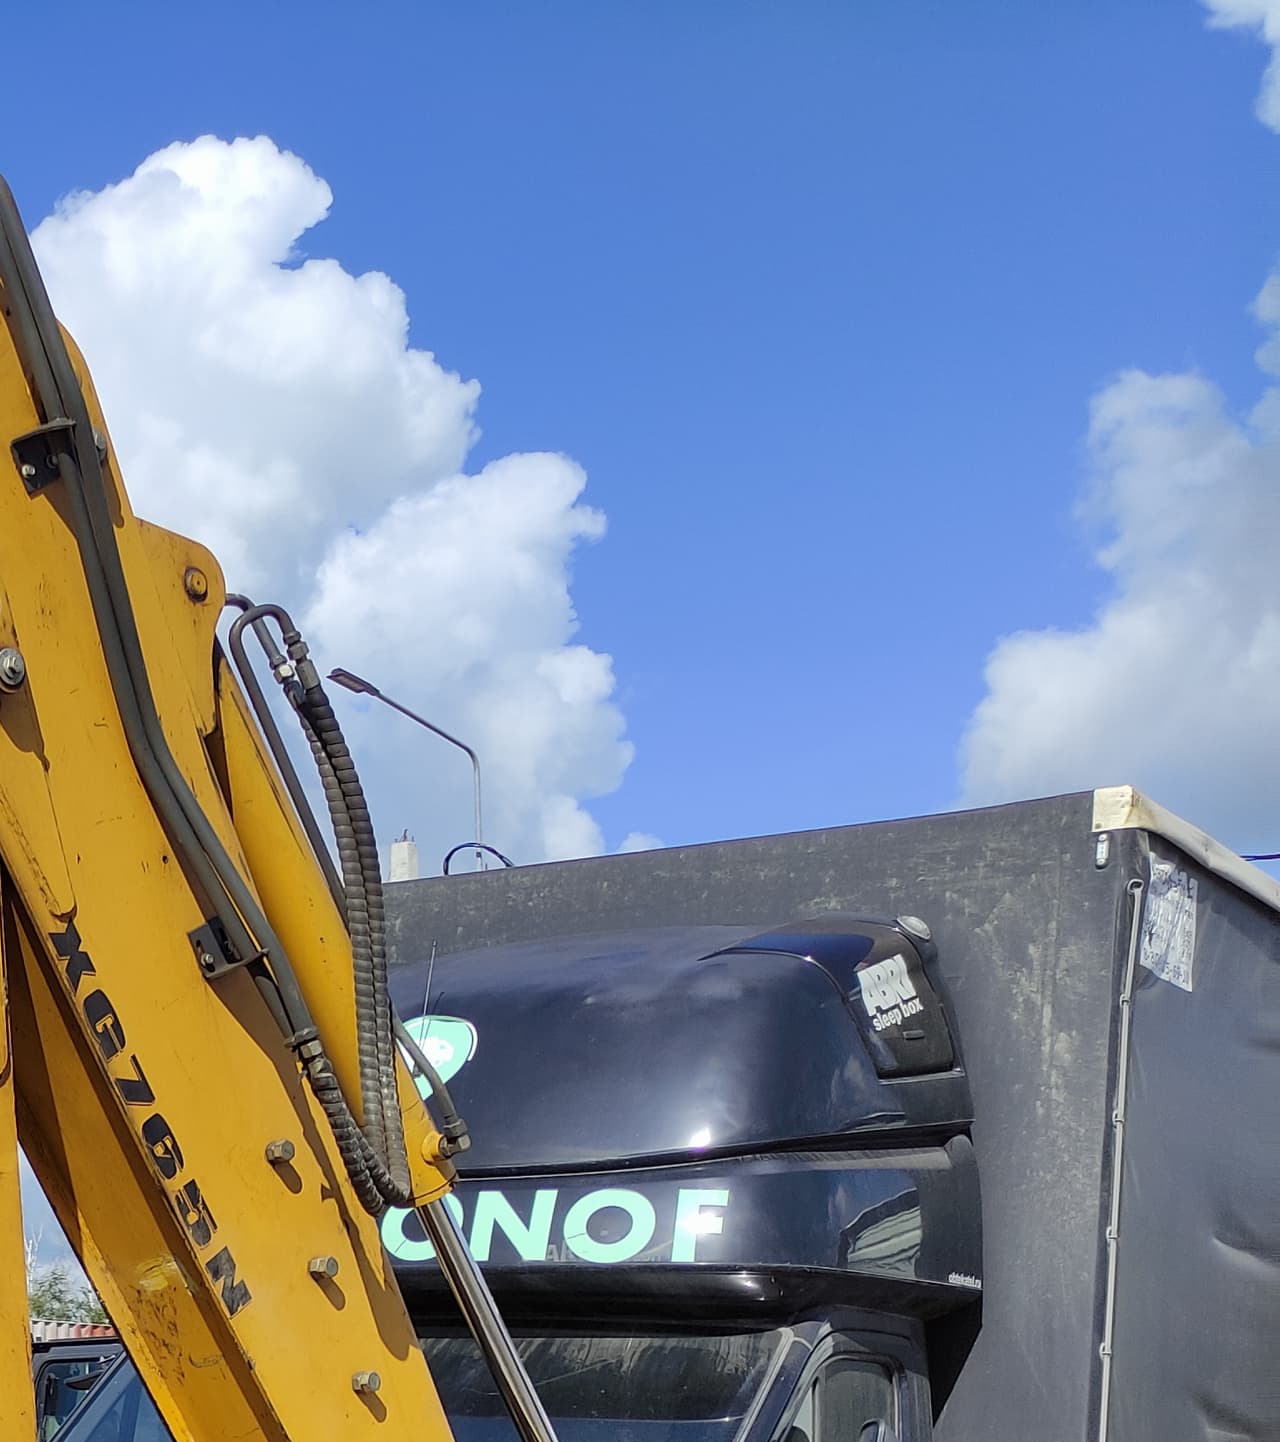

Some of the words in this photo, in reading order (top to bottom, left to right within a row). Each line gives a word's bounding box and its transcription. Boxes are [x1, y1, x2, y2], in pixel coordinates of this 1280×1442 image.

[48, 918, 252, 1318] XG765N
[873, 1007, 902, 1032] sleep
[900, 998, 924, 1018] box
